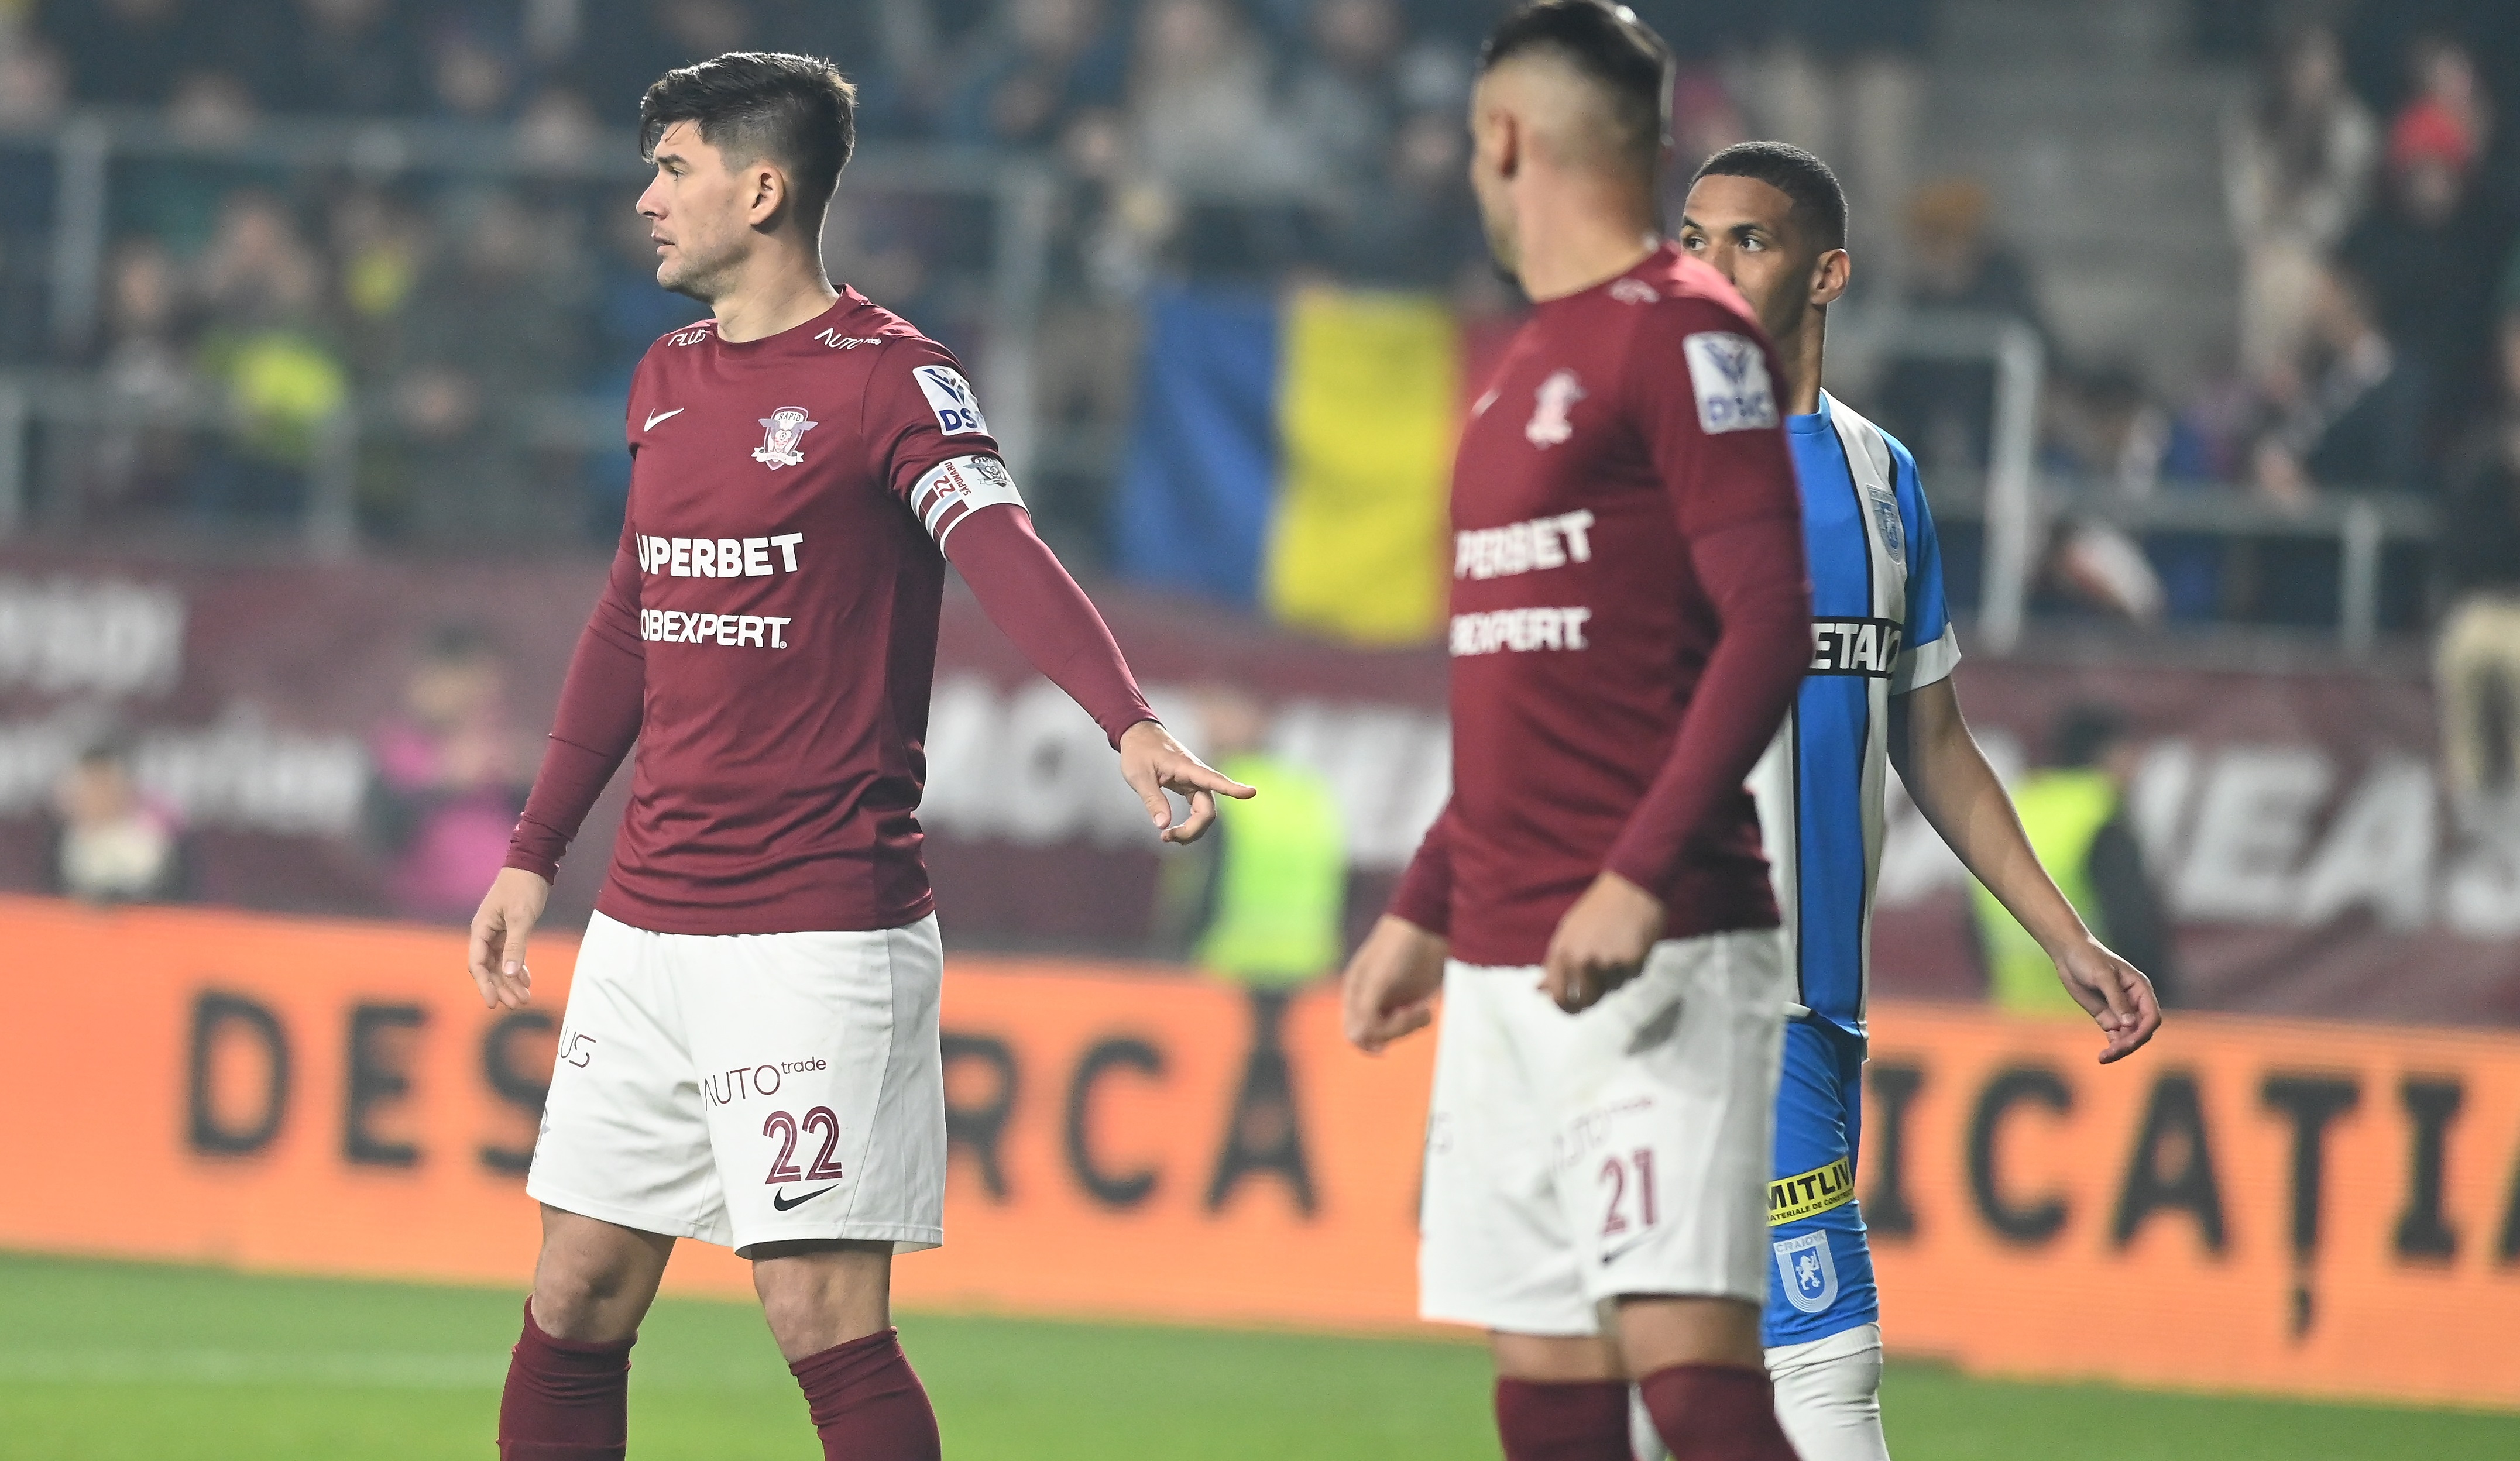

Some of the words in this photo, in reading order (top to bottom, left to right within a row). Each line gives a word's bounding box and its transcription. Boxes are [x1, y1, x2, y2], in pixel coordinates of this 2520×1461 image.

[778, 412, 801, 421] RAPID
[933, 475, 956, 499] 22
[558, 1026, 597, 1068] US
[781, 1056, 827, 1075] trade
[763, 1106, 843, 1185] 22
[1599, 1149, 1657, 1237] 21
[1812, 1201, 1822, 1210] DE
[1776, 1232, 1825, 1253] CRAIOVA
